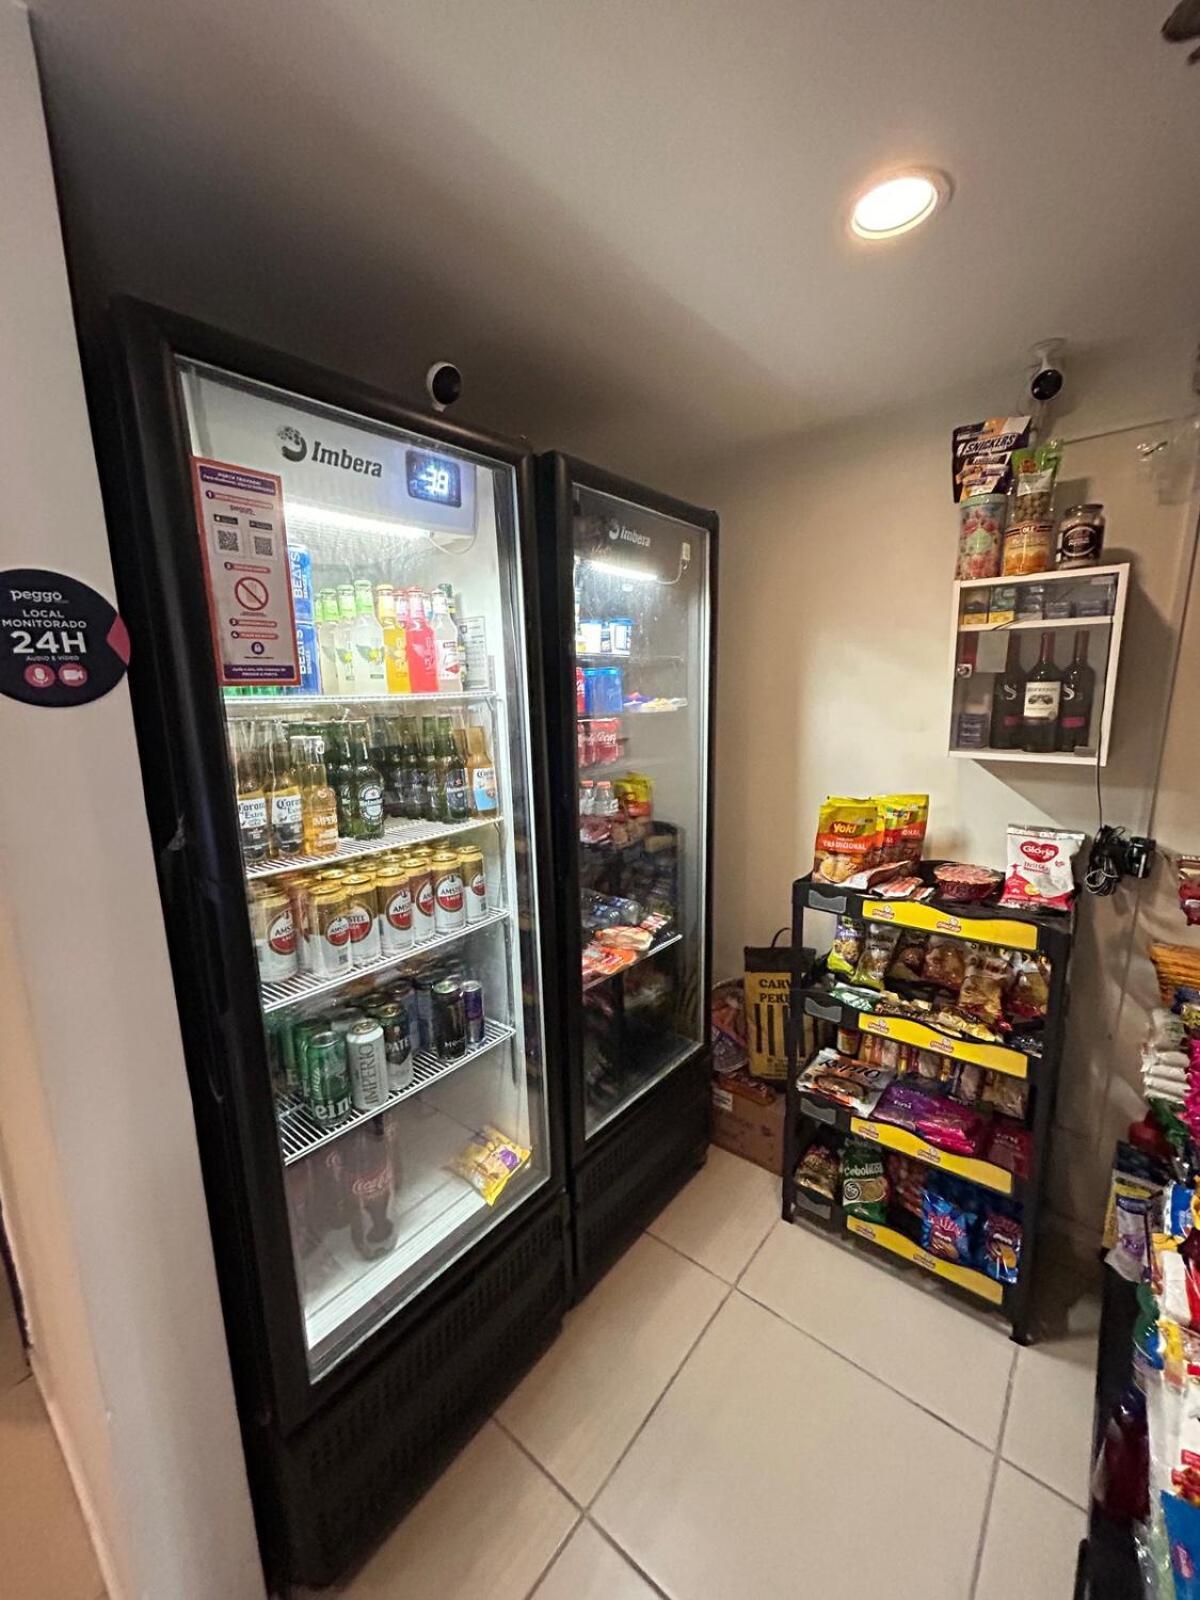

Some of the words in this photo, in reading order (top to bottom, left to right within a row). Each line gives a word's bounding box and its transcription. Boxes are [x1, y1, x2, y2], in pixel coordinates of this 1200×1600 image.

[963, 434, 1017, 454] SNICKERS
[311, 441, 383, 477] Imbera
[290, 550, 303, 599] BEATS
[10, 590, 63, 603] peggo
[2, 619, 88, 628] MONITORADO
[22, 609, 65, 618] LOCAL
[10, 630, 87, 654] 24H
